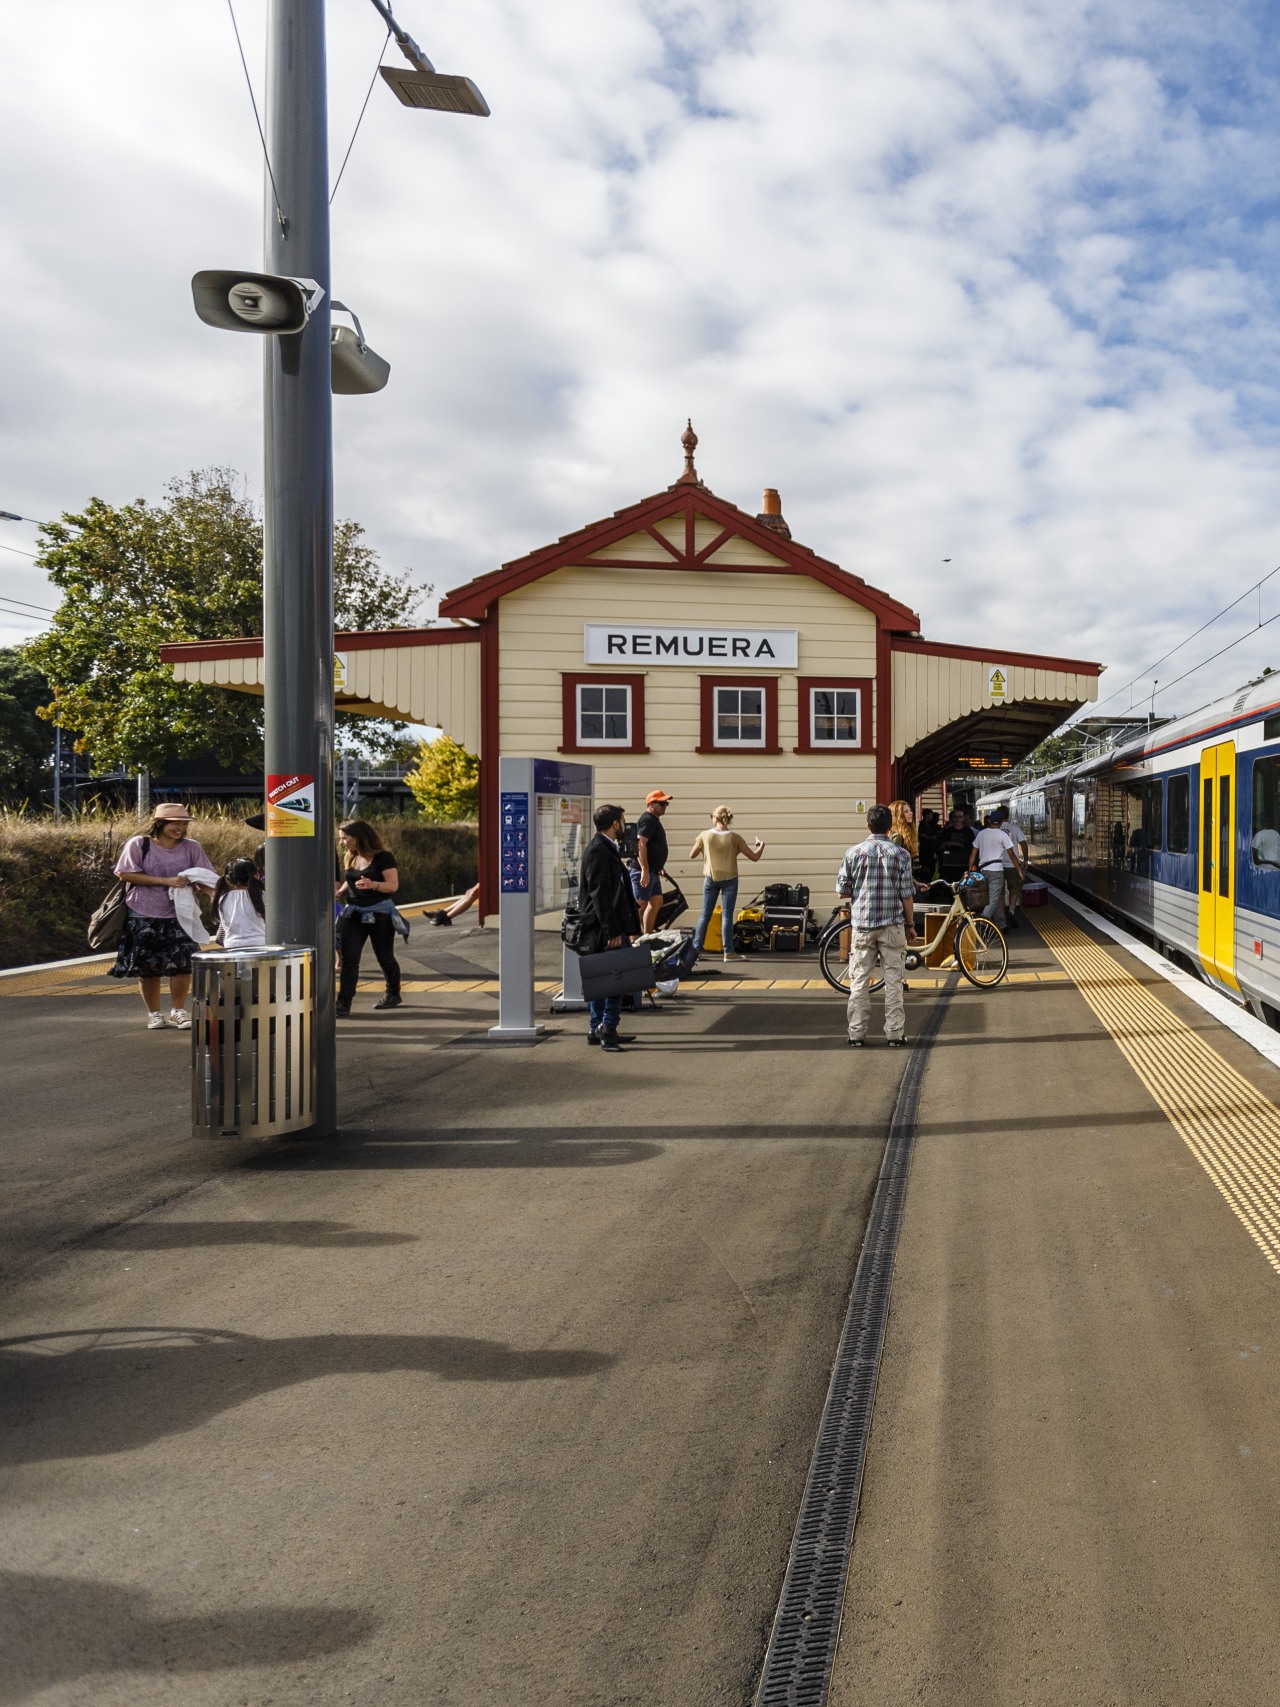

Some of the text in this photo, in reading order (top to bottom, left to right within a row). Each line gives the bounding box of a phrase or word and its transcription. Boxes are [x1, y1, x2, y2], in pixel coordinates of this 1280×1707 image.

[607, 634, 776, 658] REMUERA
[269, 783, 286, 798] WATCH
[286, 777, 299, 787] OUT
